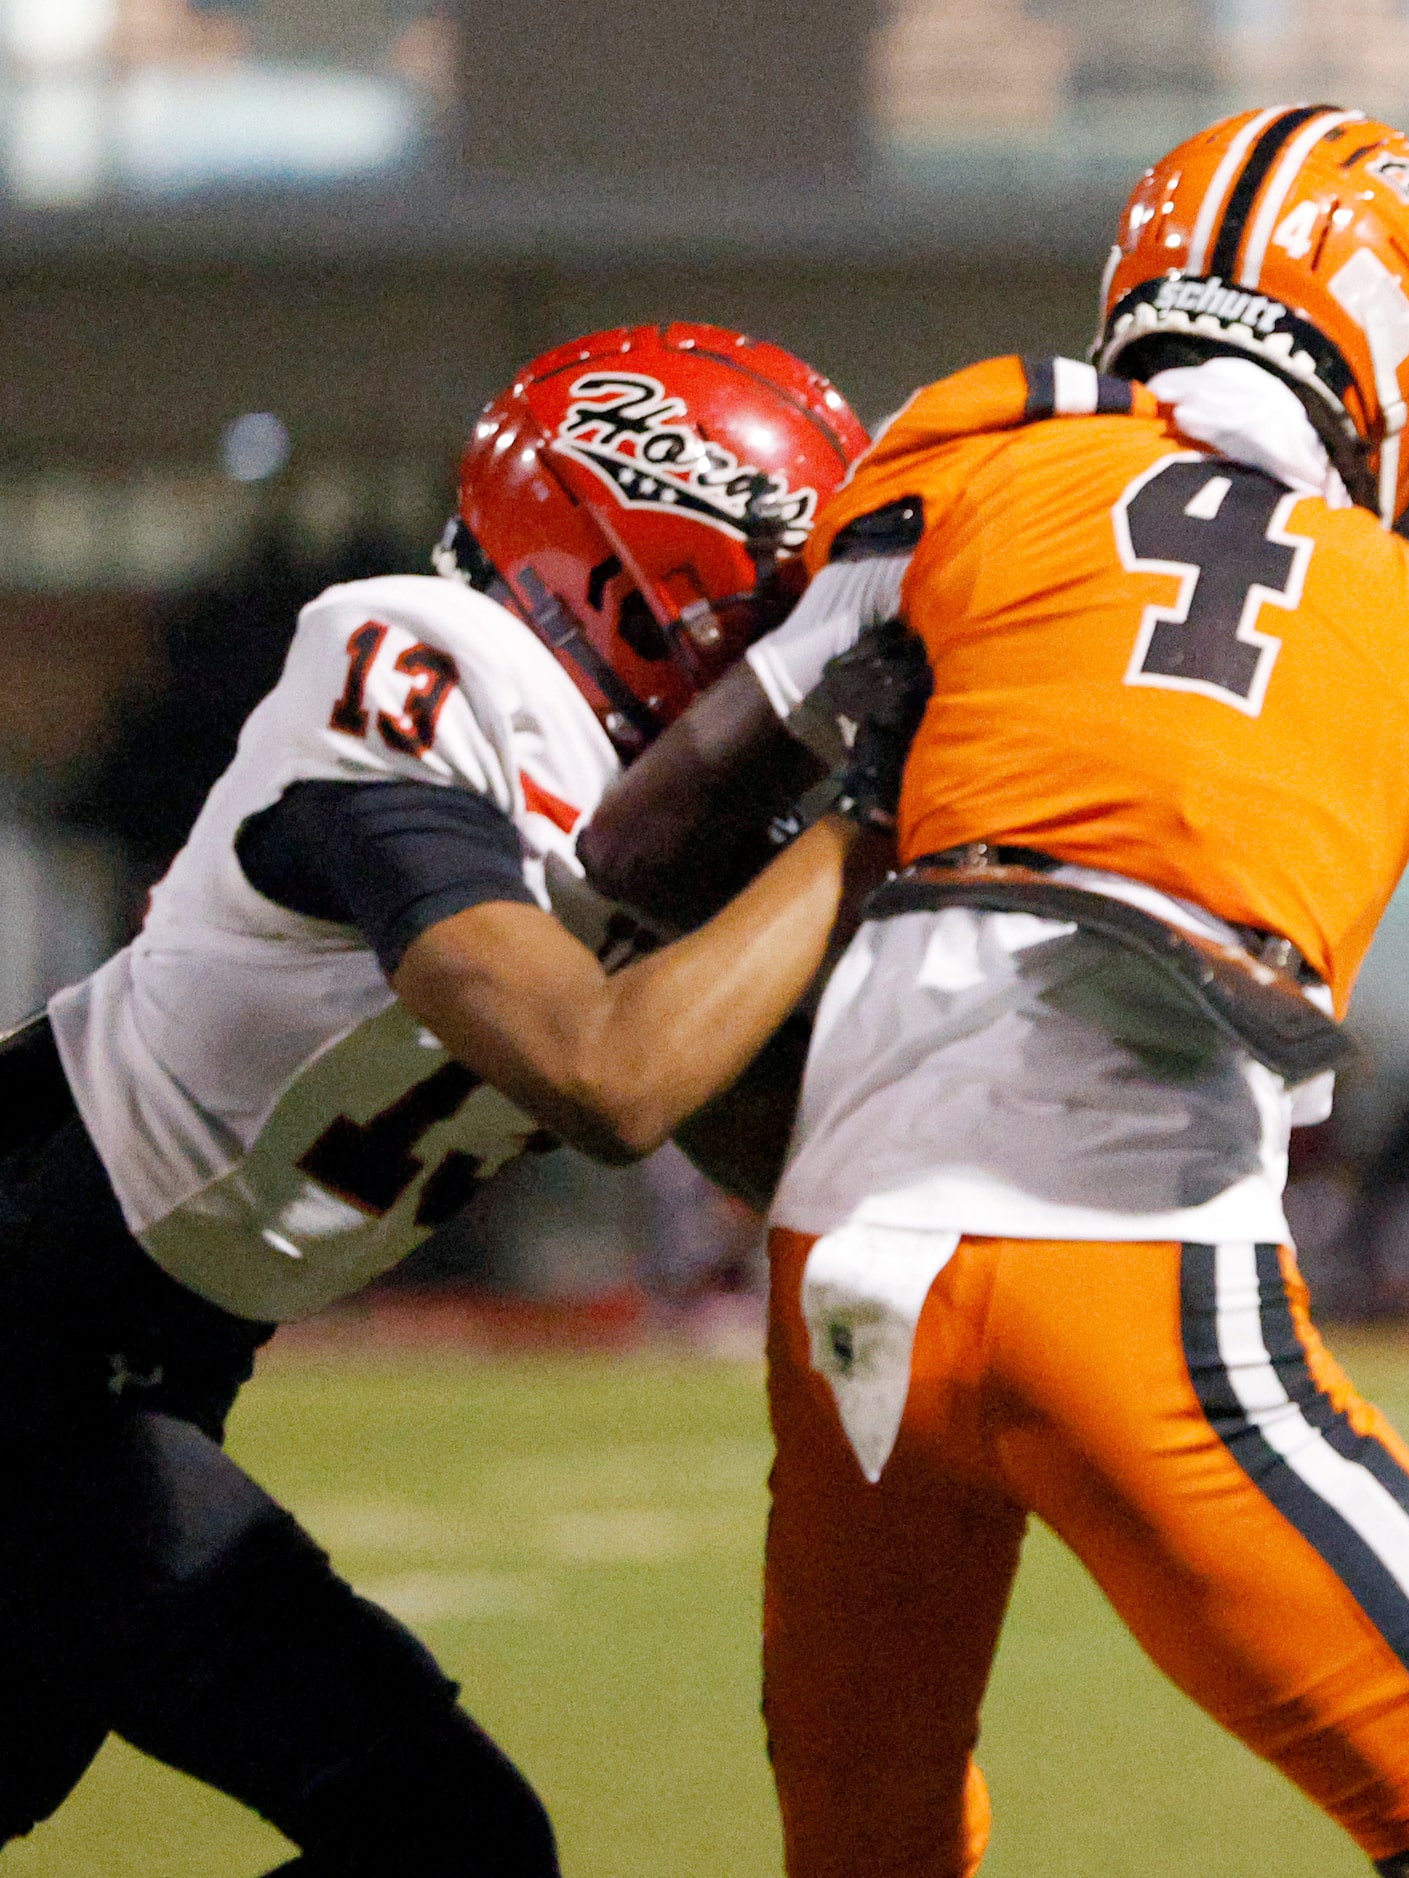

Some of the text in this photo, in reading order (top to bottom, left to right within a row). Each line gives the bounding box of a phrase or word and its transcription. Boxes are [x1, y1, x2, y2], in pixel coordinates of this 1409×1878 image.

[1272, 200, 1320, 259] 4
[1111, 450, 1315, 719] 4
[328, 620, 462, 758] 13
